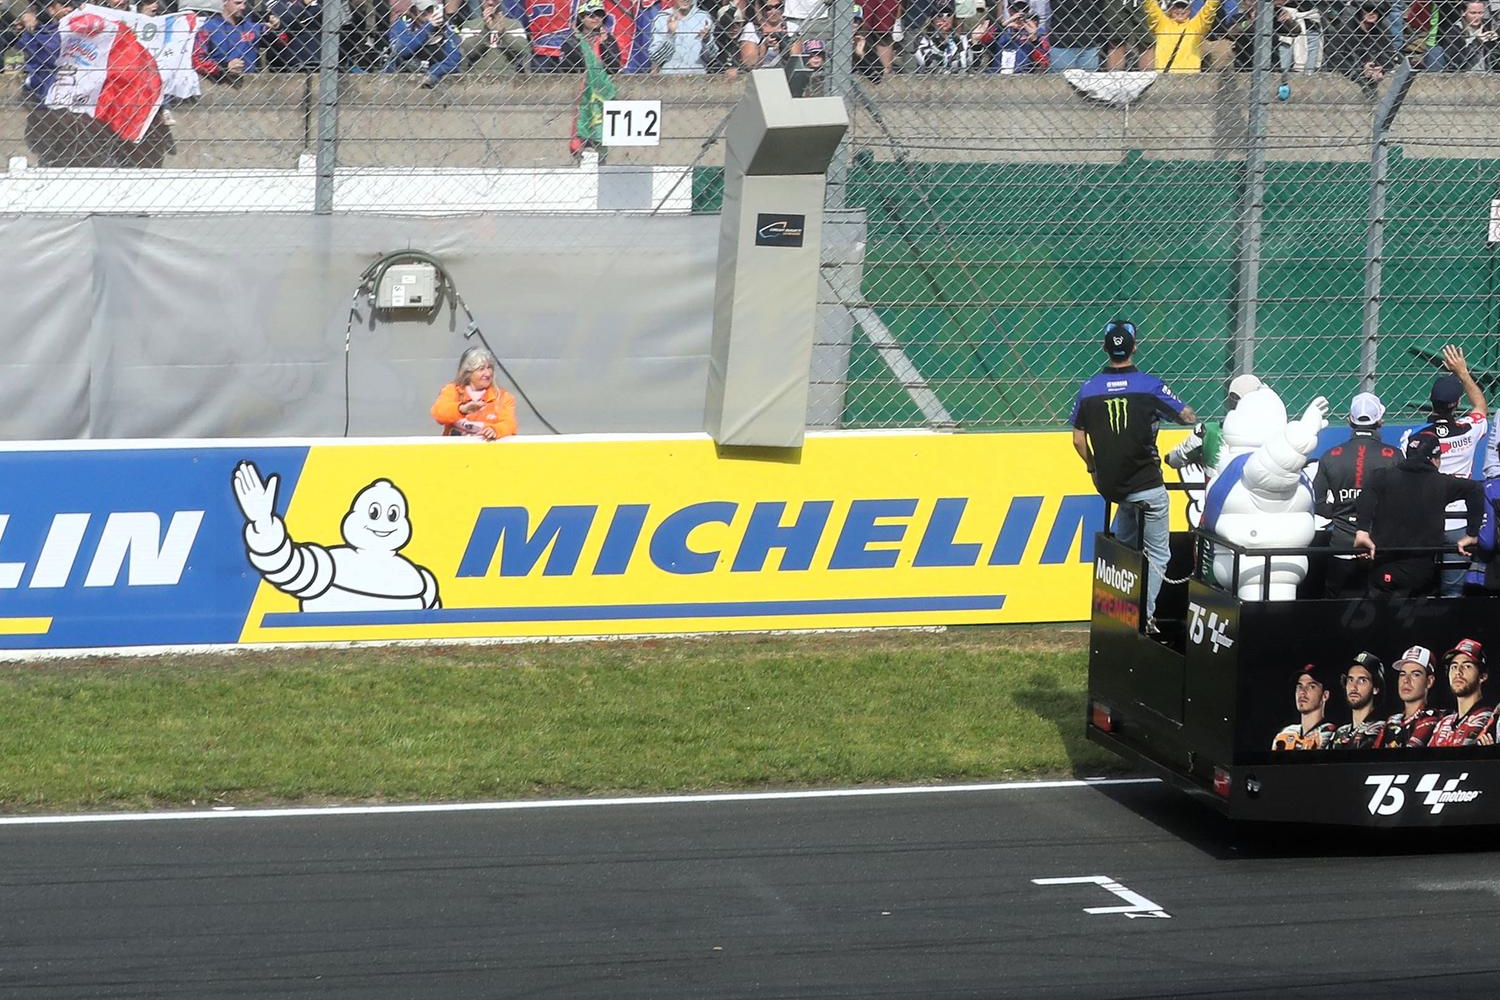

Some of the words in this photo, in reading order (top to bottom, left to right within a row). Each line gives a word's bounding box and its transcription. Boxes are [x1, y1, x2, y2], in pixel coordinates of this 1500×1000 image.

[606, 110, 658, 136] T1.2
[1095, 593, 1140, 629] PREMIER
[1188, 601, 1206, 645] 75
[1364, 774, 1410, 815] 75
